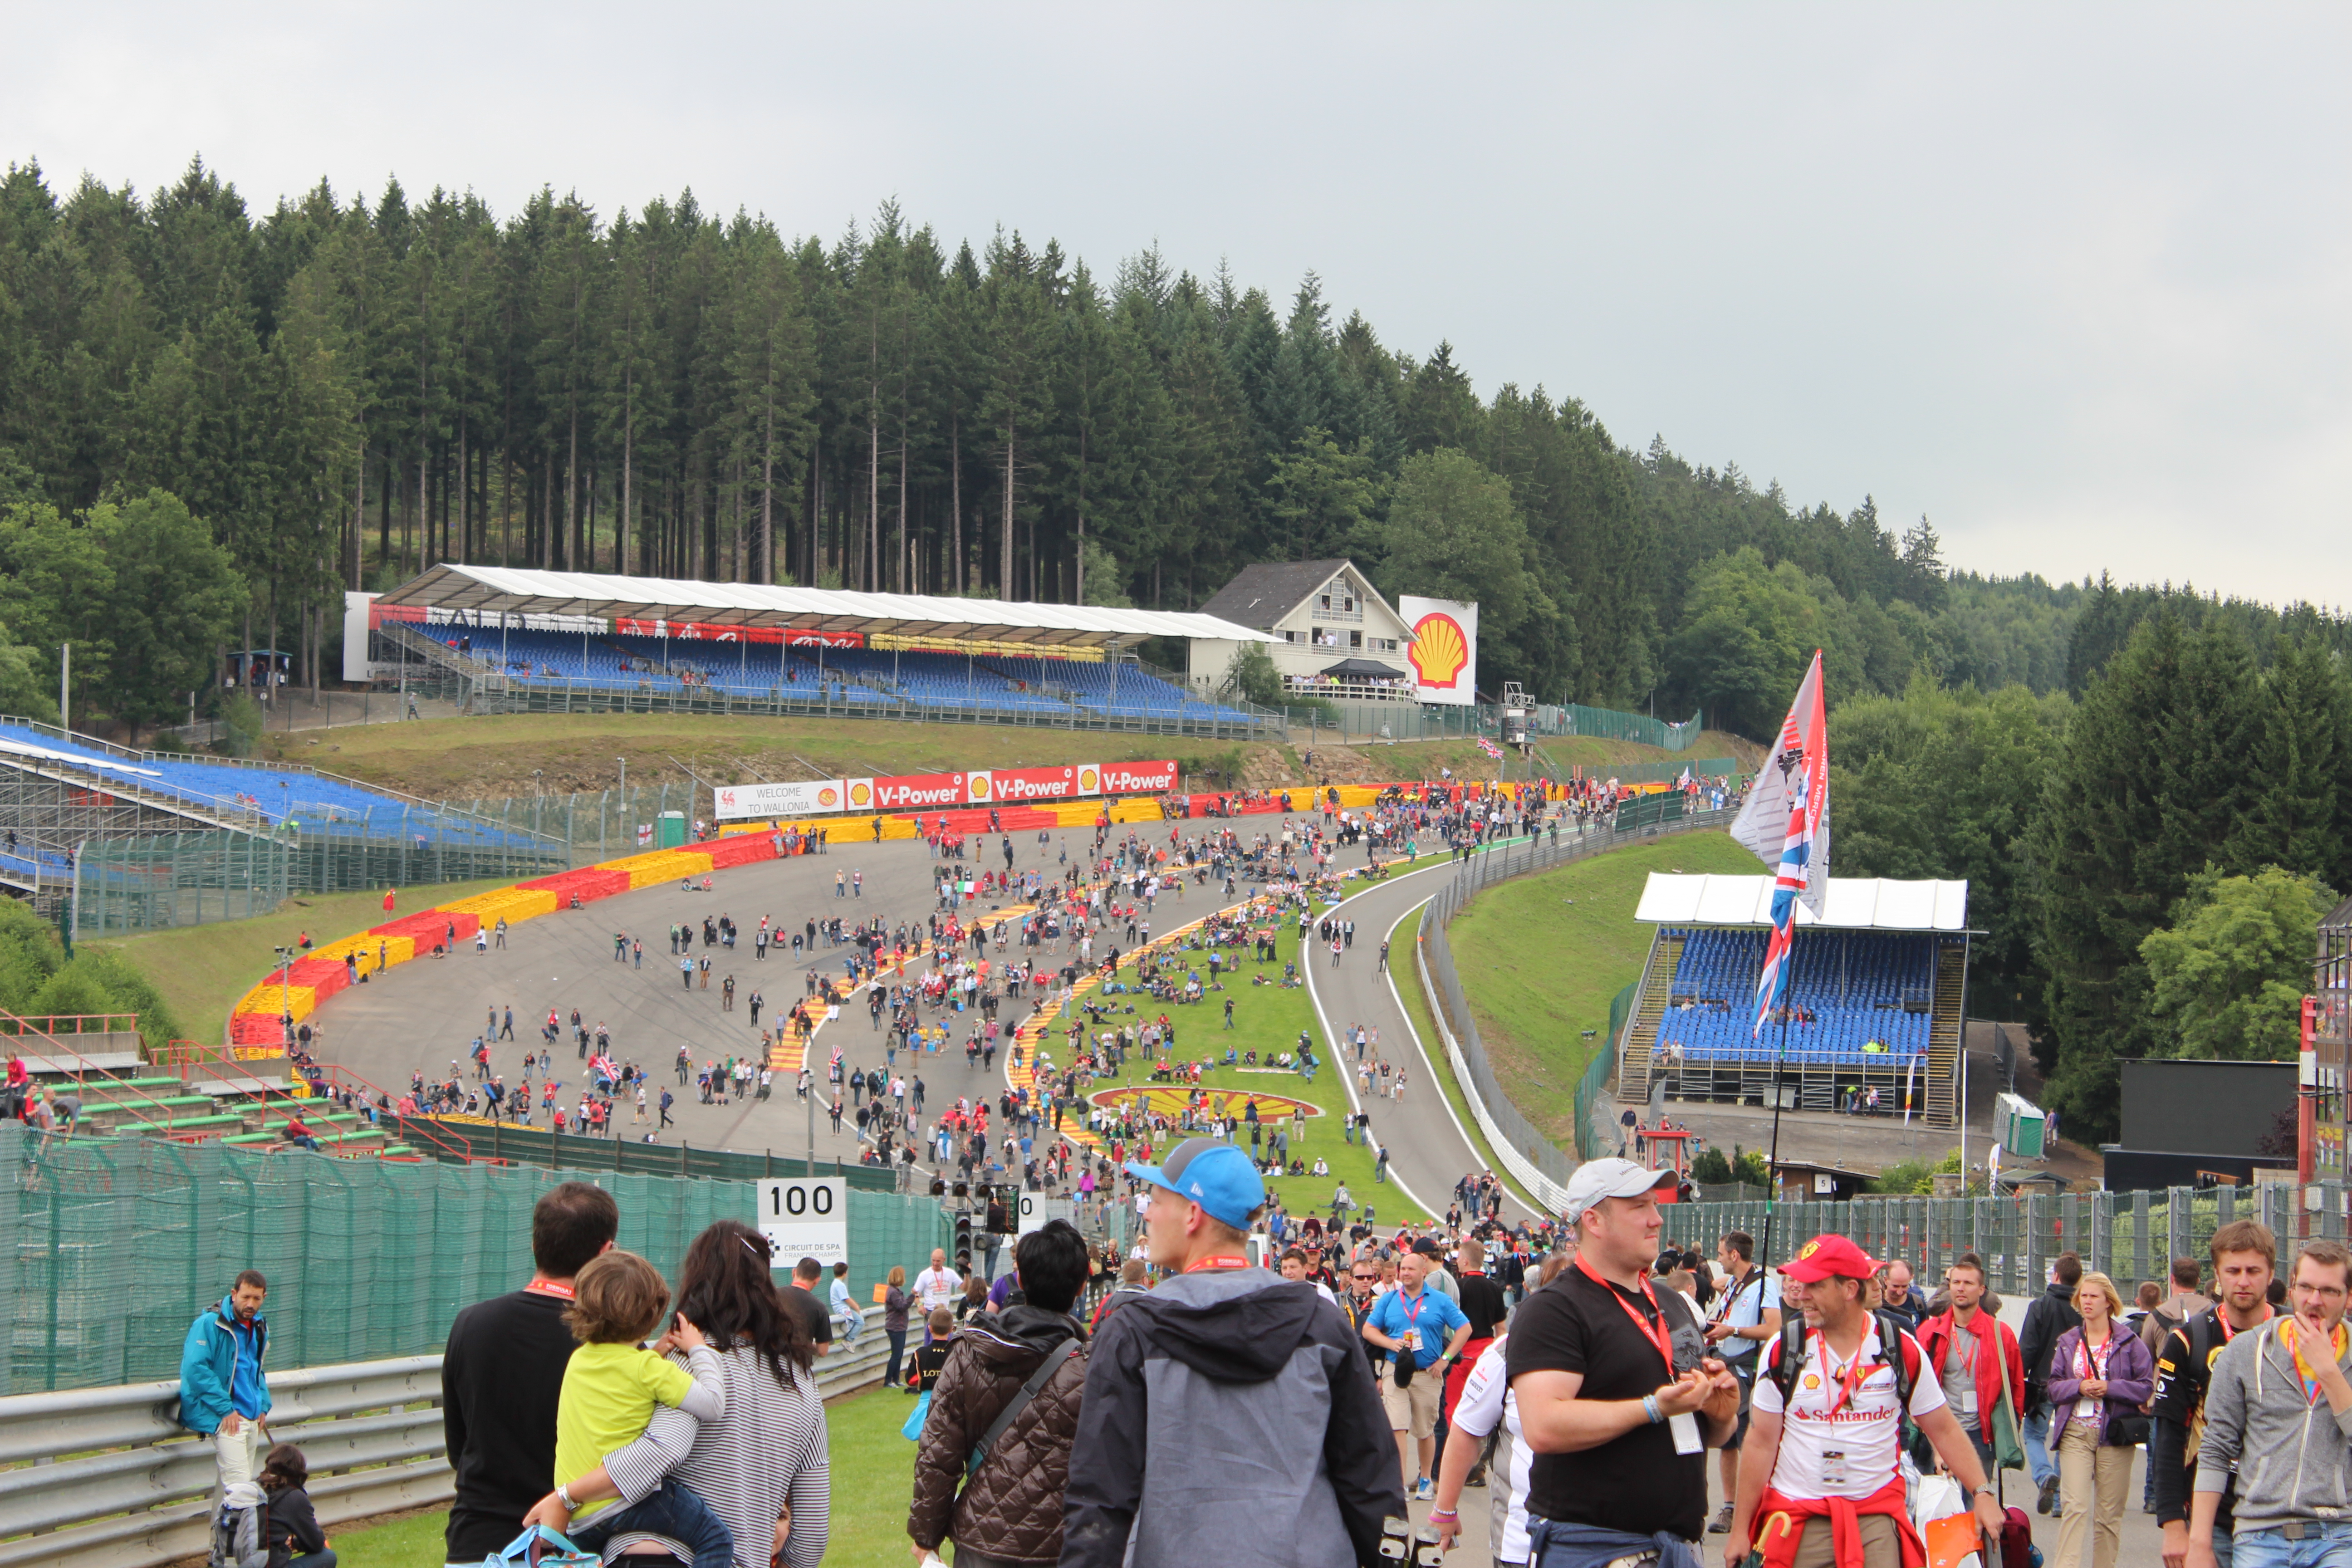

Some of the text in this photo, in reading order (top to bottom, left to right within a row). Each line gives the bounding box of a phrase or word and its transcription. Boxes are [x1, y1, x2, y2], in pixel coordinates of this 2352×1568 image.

[995, 779, 1069, 799] V-Power
[1103, 772, 1171, 791] V-Power
[756, 787, 801, 799] WELCOME
[877, 786, 959, 806] V-Power
[748, 801, 809, 814] TO WALLONIA
[771, 1186, 832, 1215] 100
[1021, 1198, 1032, 1215] 0
[546, 1284, 569, 1294] FORMULA
[1813, 1406, 1896, 1422] Santander
